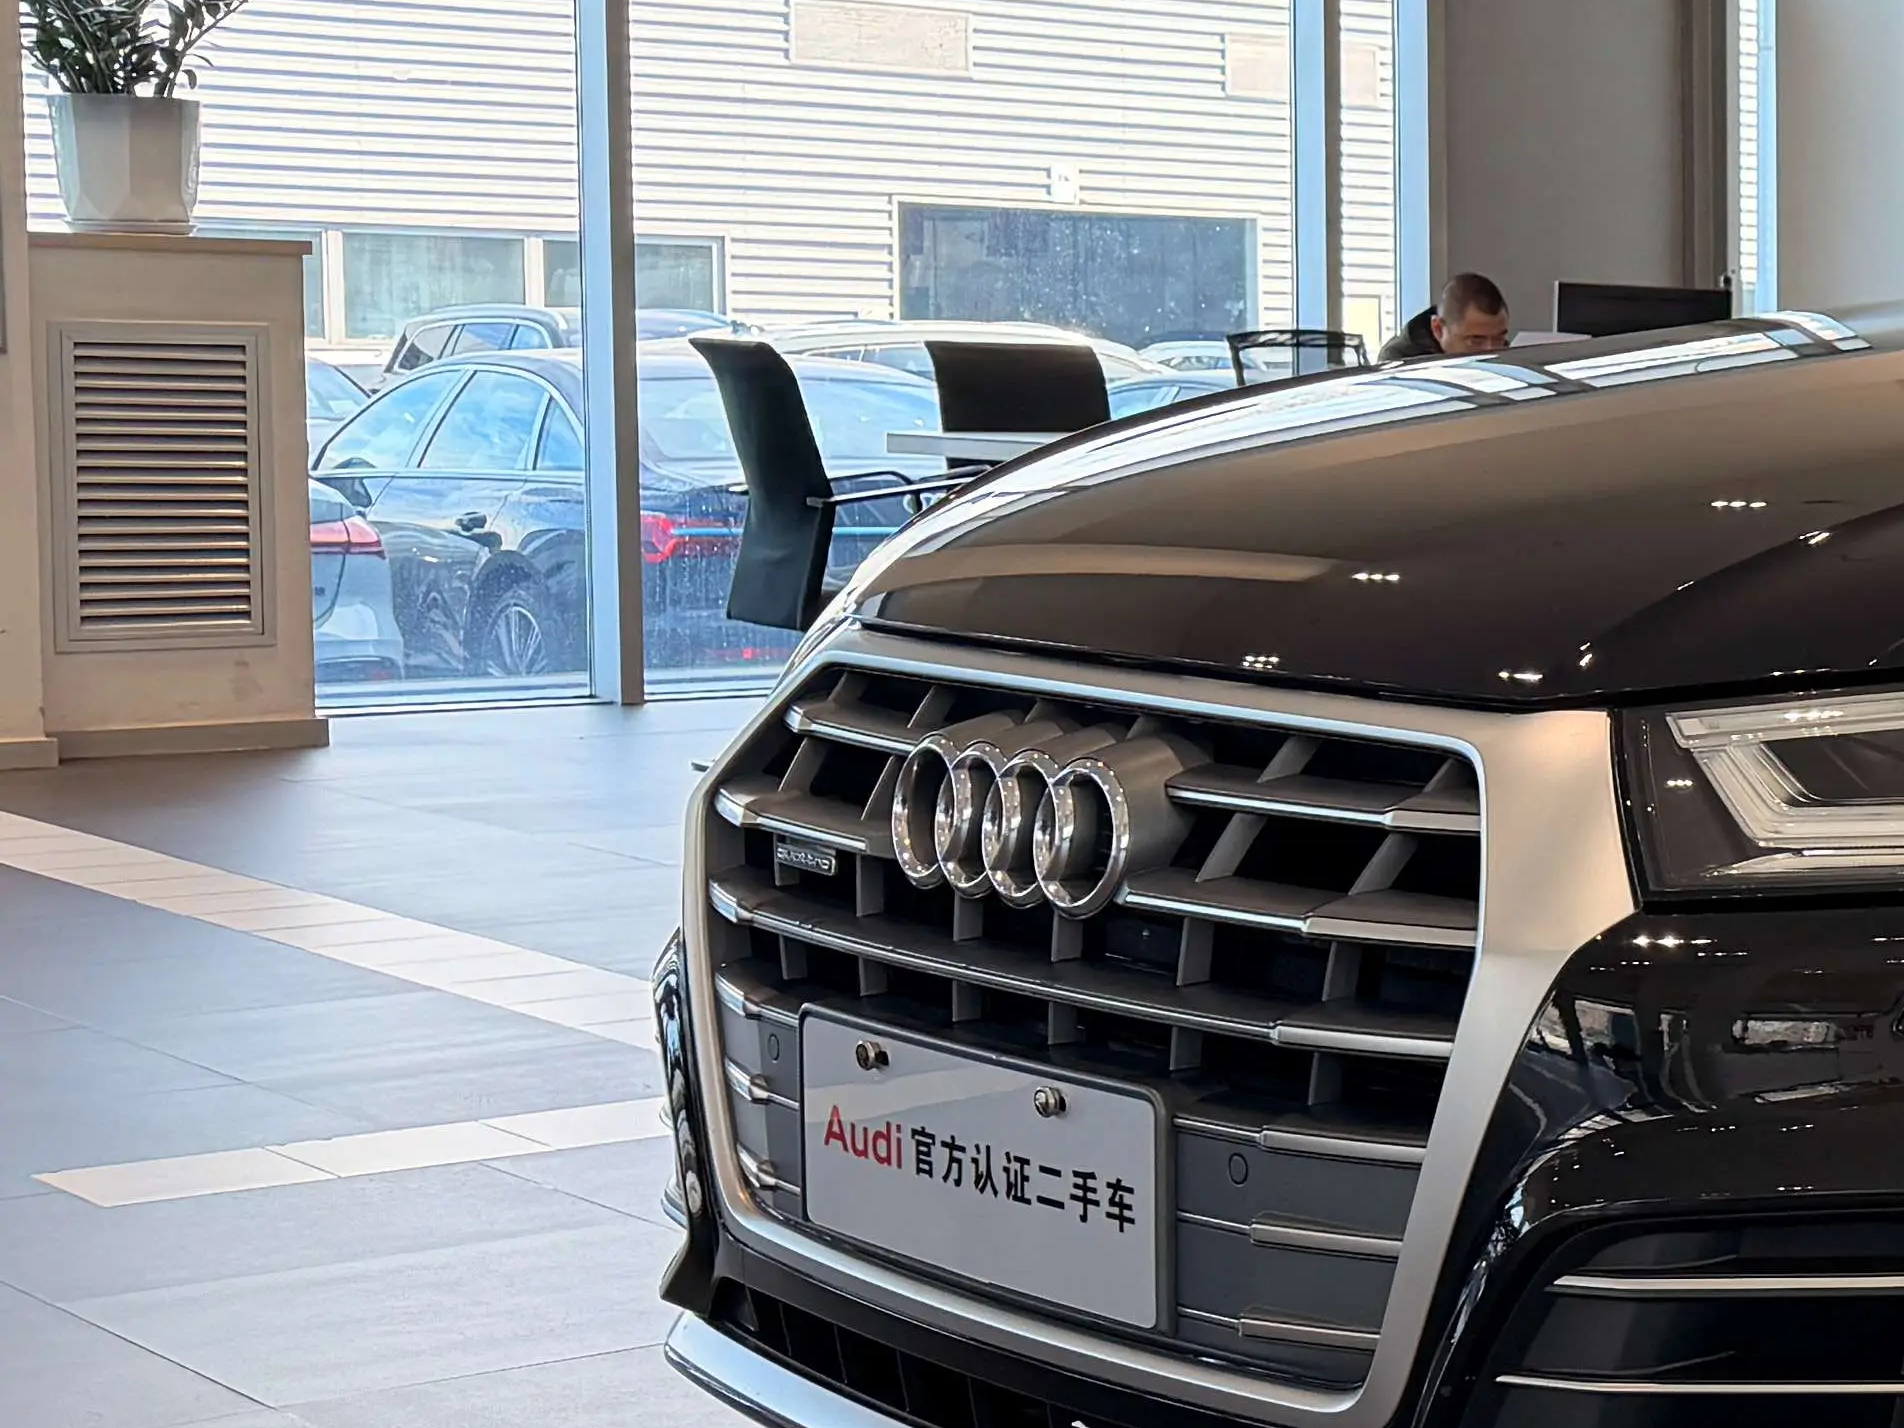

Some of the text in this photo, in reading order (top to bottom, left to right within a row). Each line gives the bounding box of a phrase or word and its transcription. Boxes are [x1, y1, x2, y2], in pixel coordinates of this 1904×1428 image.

[823, 1104, 1136, 1233] Audi 官方认证二手车
